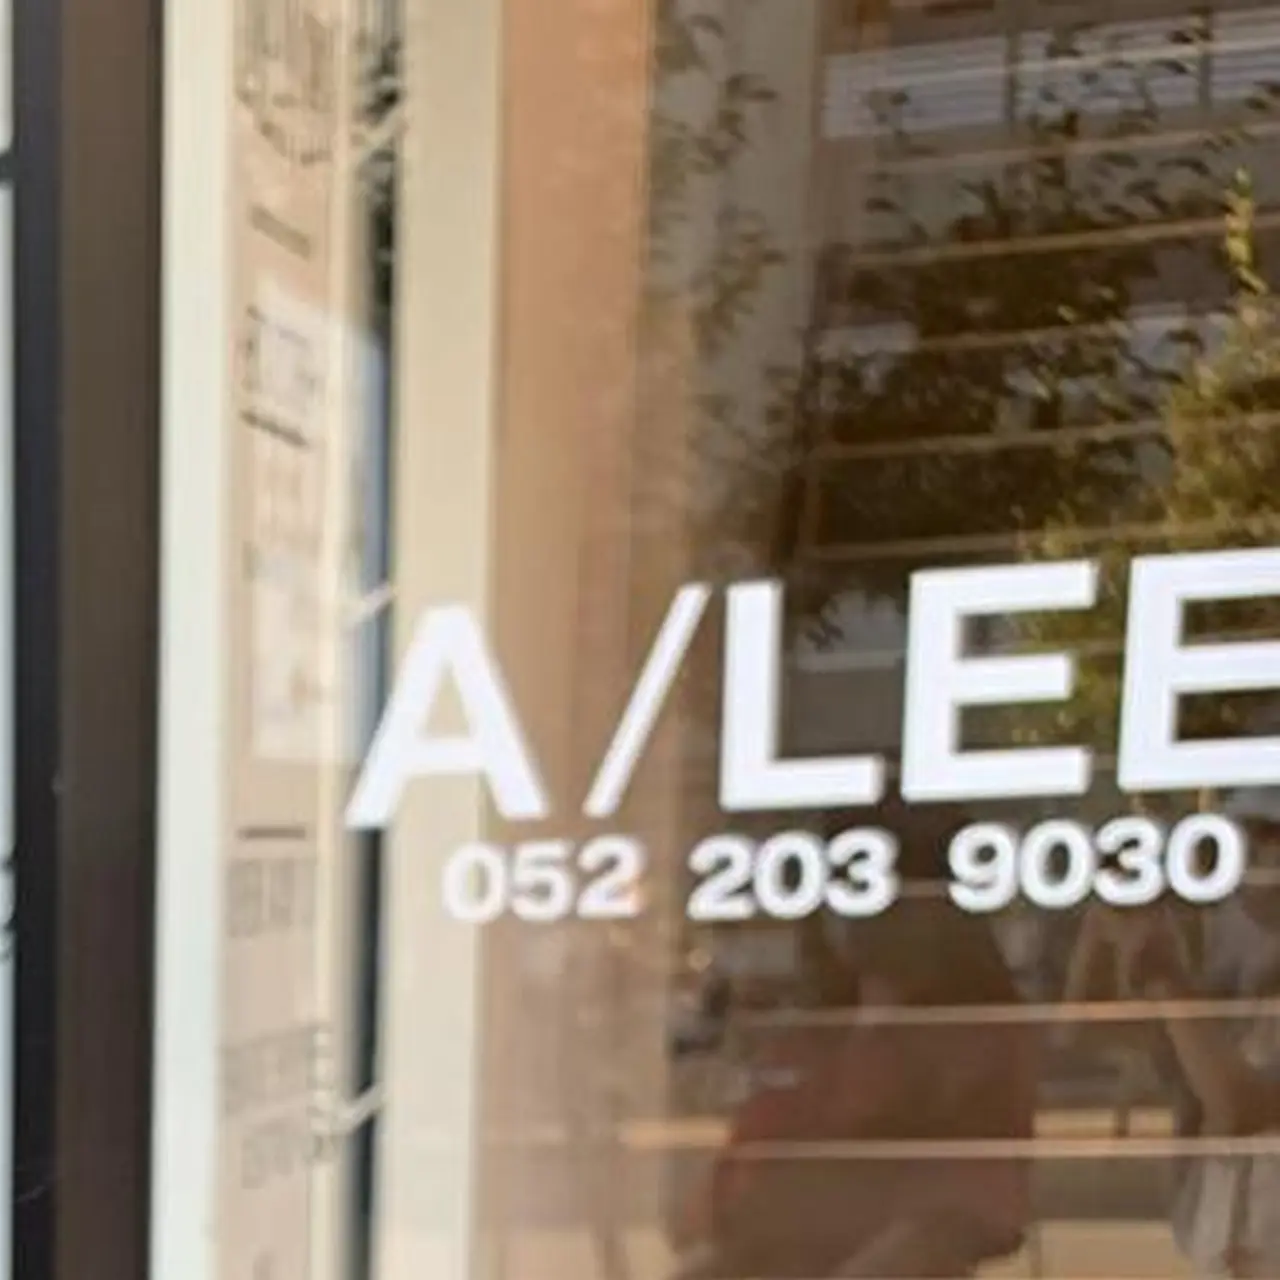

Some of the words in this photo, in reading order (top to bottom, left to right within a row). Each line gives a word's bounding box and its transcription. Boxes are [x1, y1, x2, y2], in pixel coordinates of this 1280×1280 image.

[441, 840, 646, 923] 052
[687, 827, 898, 921] 203
[948, 813, 1244, 914] 9030
